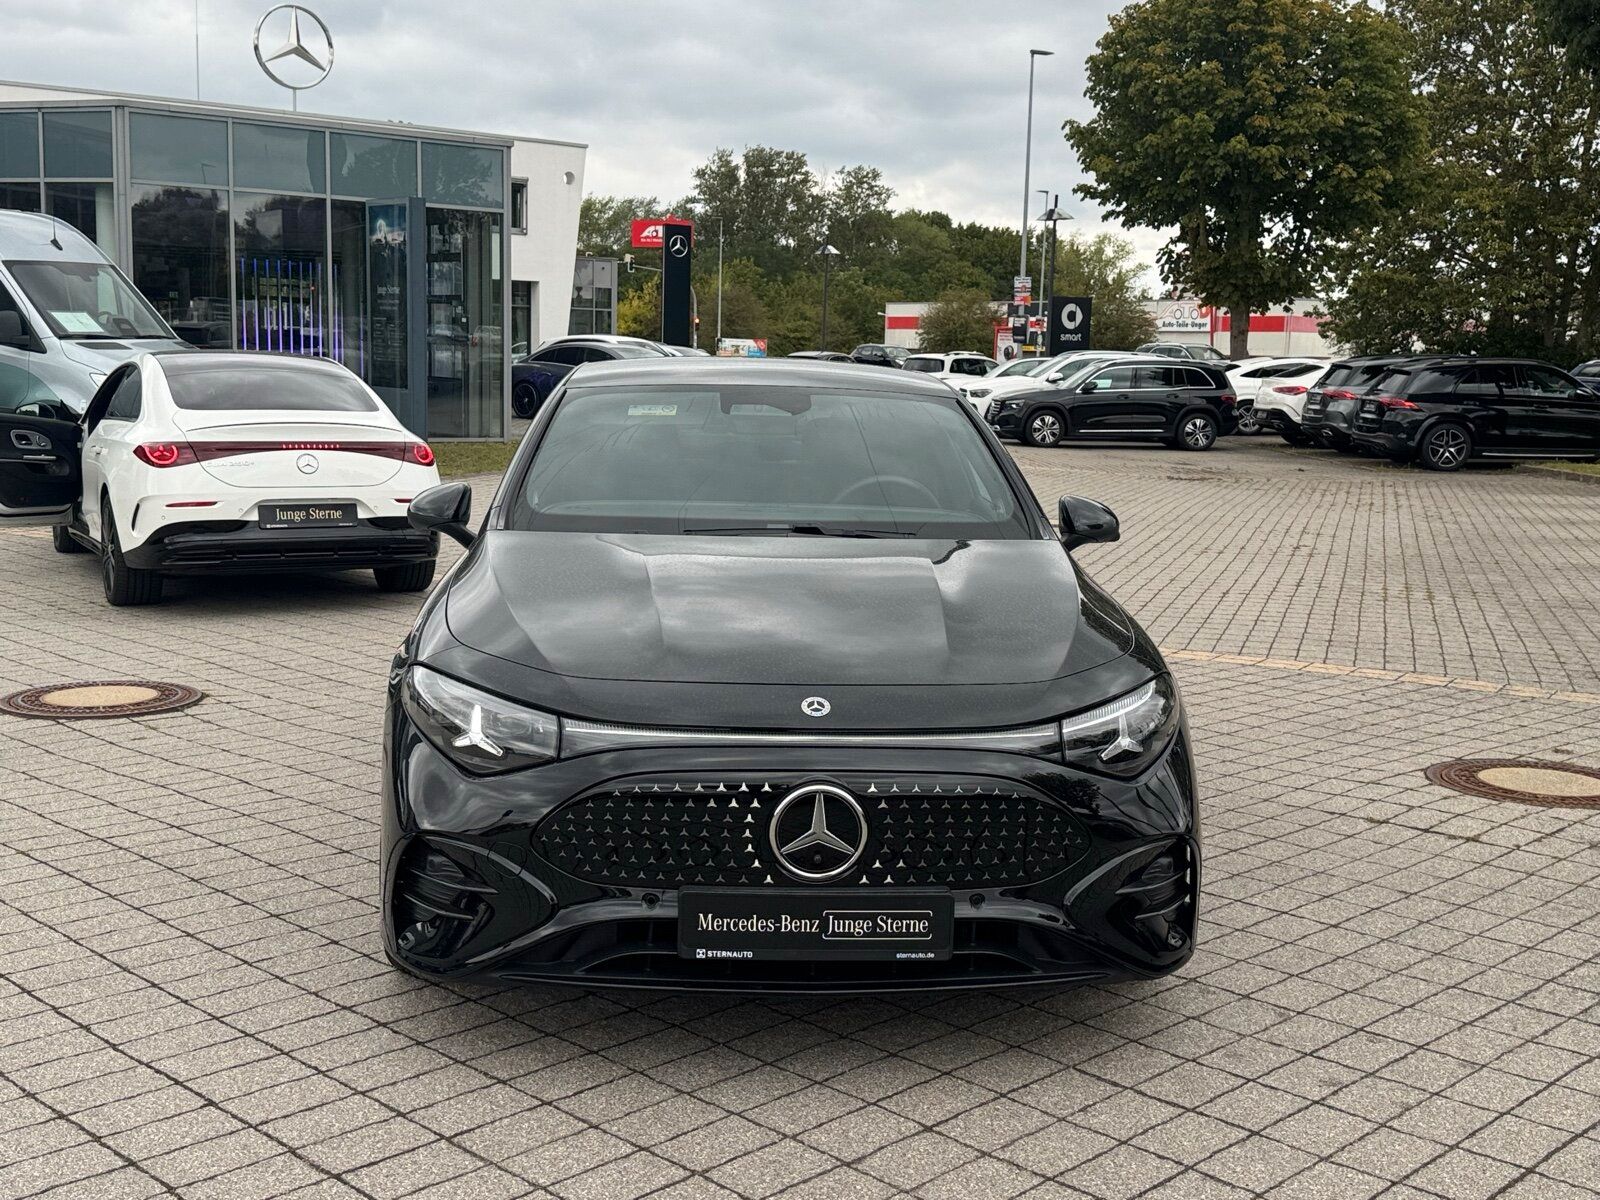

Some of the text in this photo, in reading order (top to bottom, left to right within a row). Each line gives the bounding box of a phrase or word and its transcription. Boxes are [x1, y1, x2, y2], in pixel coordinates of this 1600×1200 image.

[1060, 333, 1082, 342] smart
[276, 507, 343, 523] Junge Sterne
[697, 913, 929, 936] Mercedes-Benz Junge Sterne
[707, 950, 753, 958] STERNAUTO
